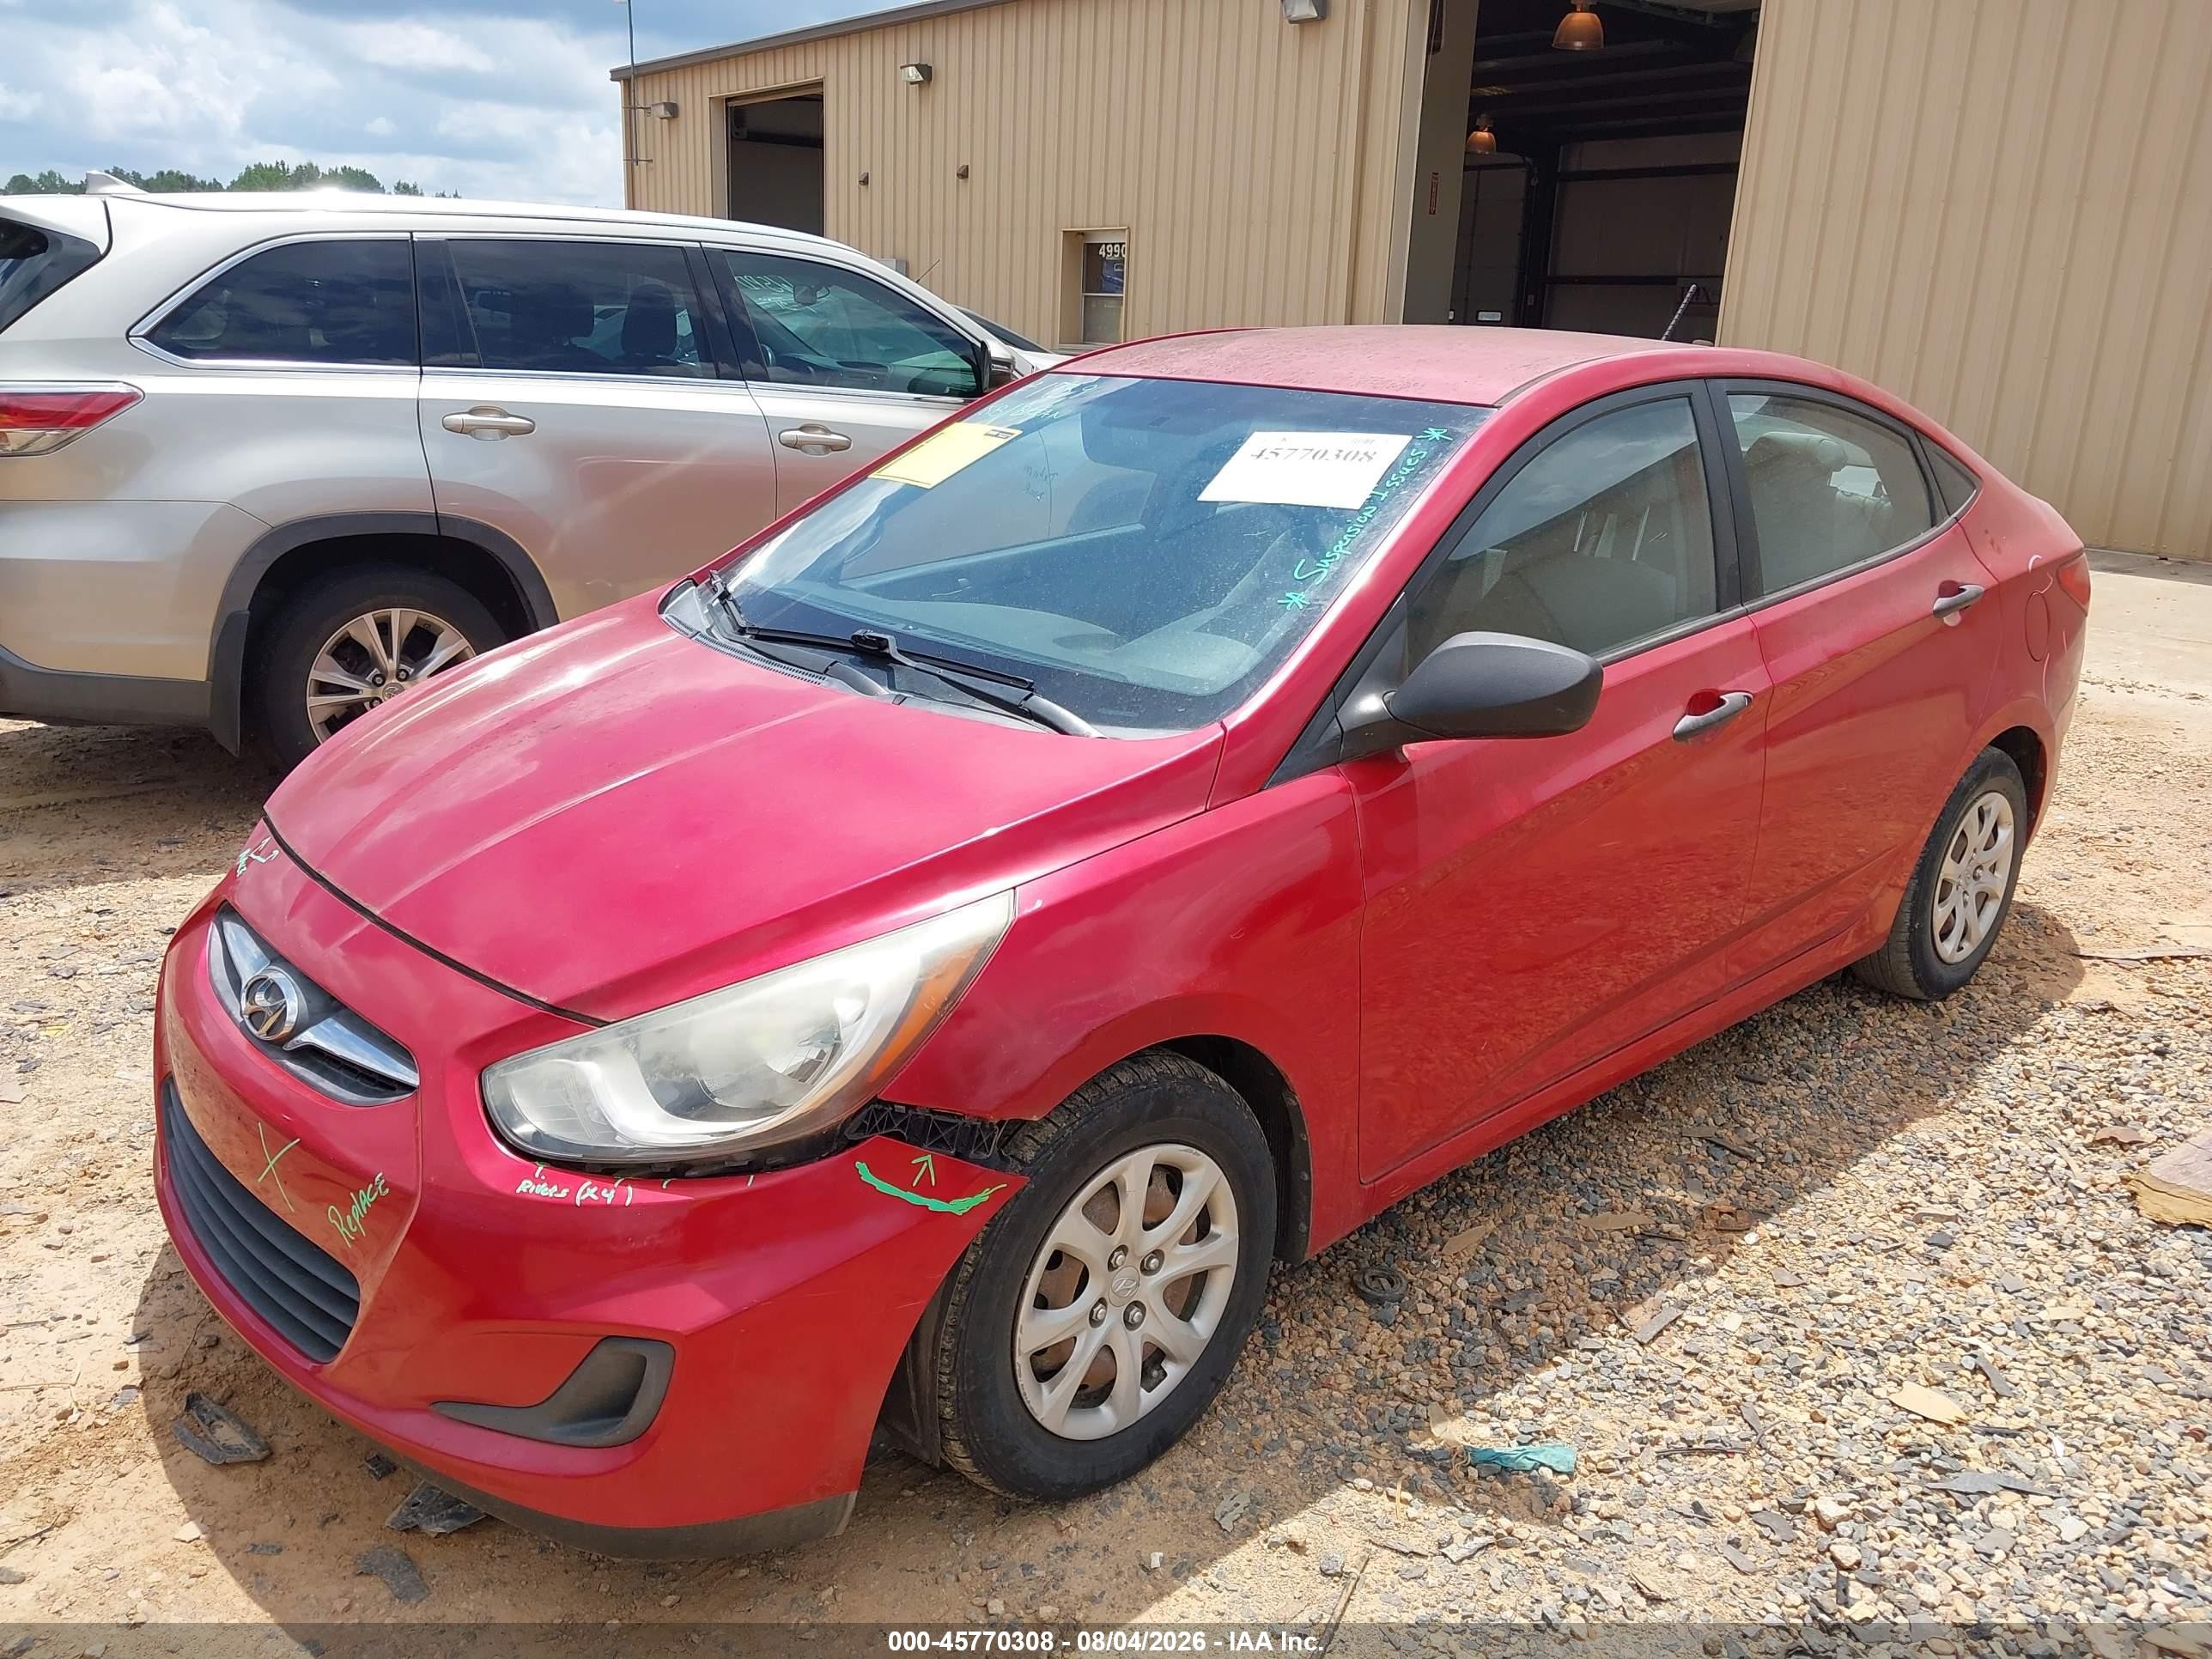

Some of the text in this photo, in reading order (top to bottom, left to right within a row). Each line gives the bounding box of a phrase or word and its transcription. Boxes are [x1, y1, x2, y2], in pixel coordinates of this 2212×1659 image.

[1250, 447, 1377, 462] 45770308
[1293, 448, 1428, 585] Suspension Issues
